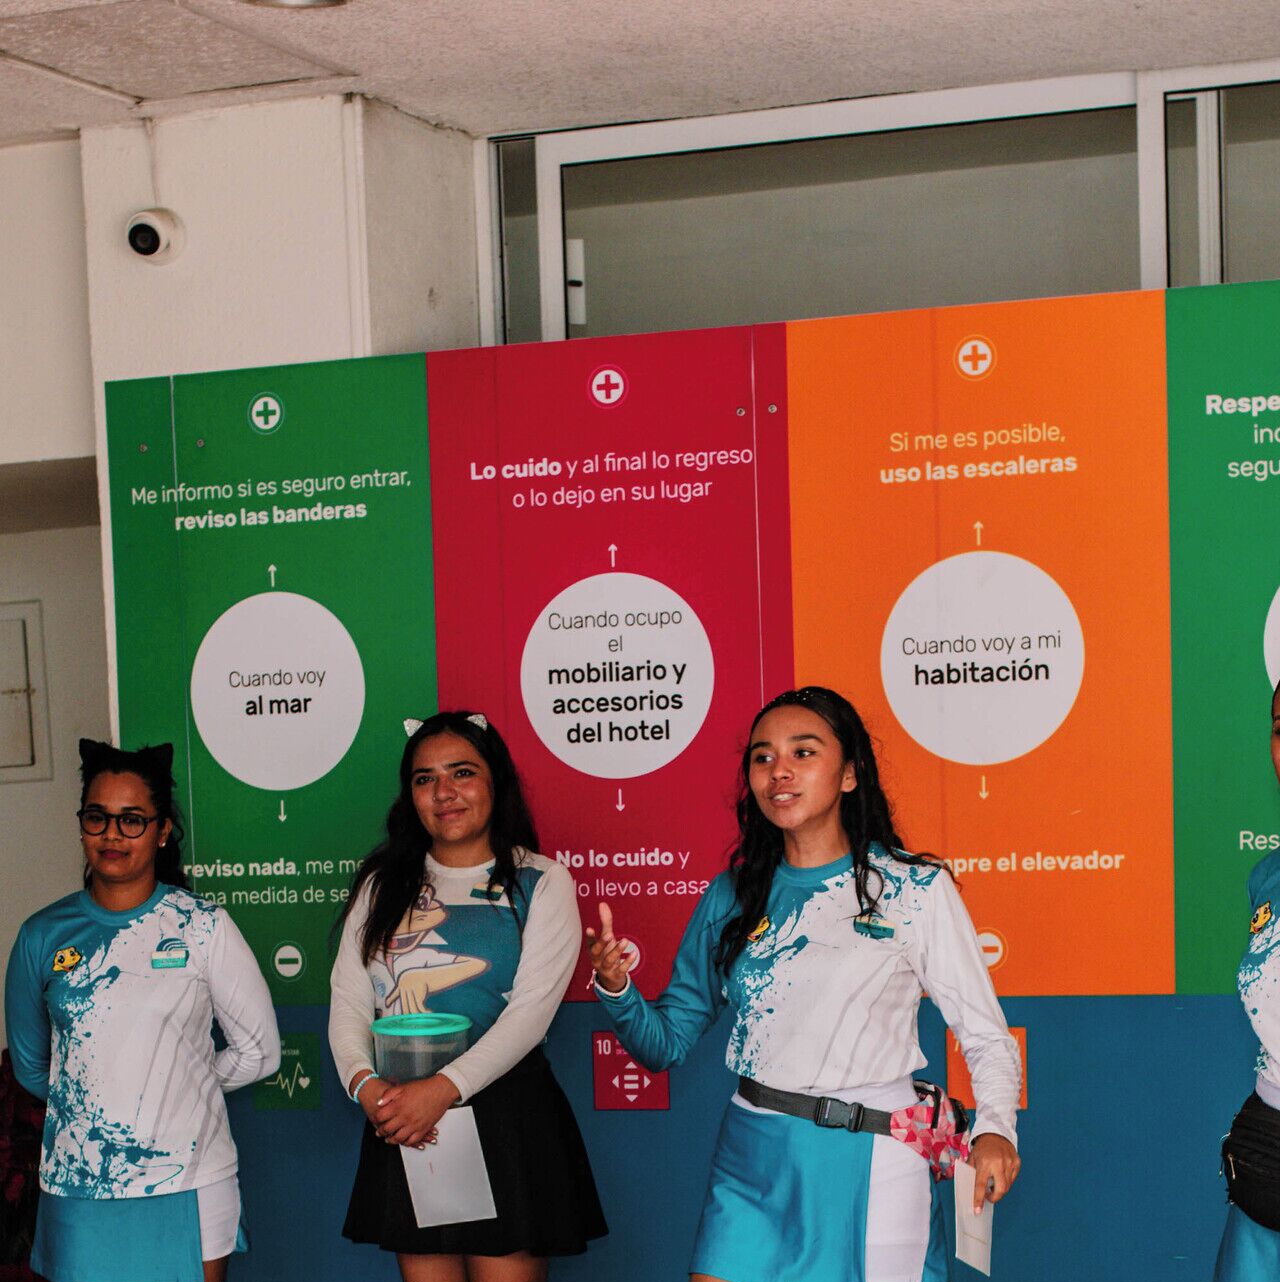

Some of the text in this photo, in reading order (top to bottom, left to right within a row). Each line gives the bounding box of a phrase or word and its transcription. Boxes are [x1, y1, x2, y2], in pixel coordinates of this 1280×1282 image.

[889, 422, 1066, 452] Si me es posible,
[470, 447, 754, 481] Lo cuido y al final lo regreso
[880, 454, 1078, 484] uso las escaleras
[131, 469, 411, 506] Me informo si es seguro entrar,
[512, 480, 713, 509] o lo dejo en su lugar
[175, 502, 367, 530] reviso las banderas
[548, 610, 683, 630] Cuando ocupo
[608, 635, 624, 653] el
[902, 630, 1062, 656] Cuando voy a mi
[229, 669, 326, 688] Cuando voy
[548, 661, 687, 686] mobiliario y
[914, 658, 1050, 685] habitación
[246, 695, 312, 717] al mar
[552, 690, 684, 714] accesorios
[567, 719, 670, 744] del hotel
[183, 859, 245, 878] reviso
[248, 858, 301, 876] nada,
[306, 860, 334, 875] me
[556, 847, 691, 870] No lo cuido y
[996, 852, 1016, 872] el
[1022, 850, 1125, 871] elevador
[232, 886, 298, 905] medida
[302, 885, 325, 904] de
[596, 878, 641, 896] llevo
[646, 881, 658, 896] a
[596, 1039, 612, 1055] 10
